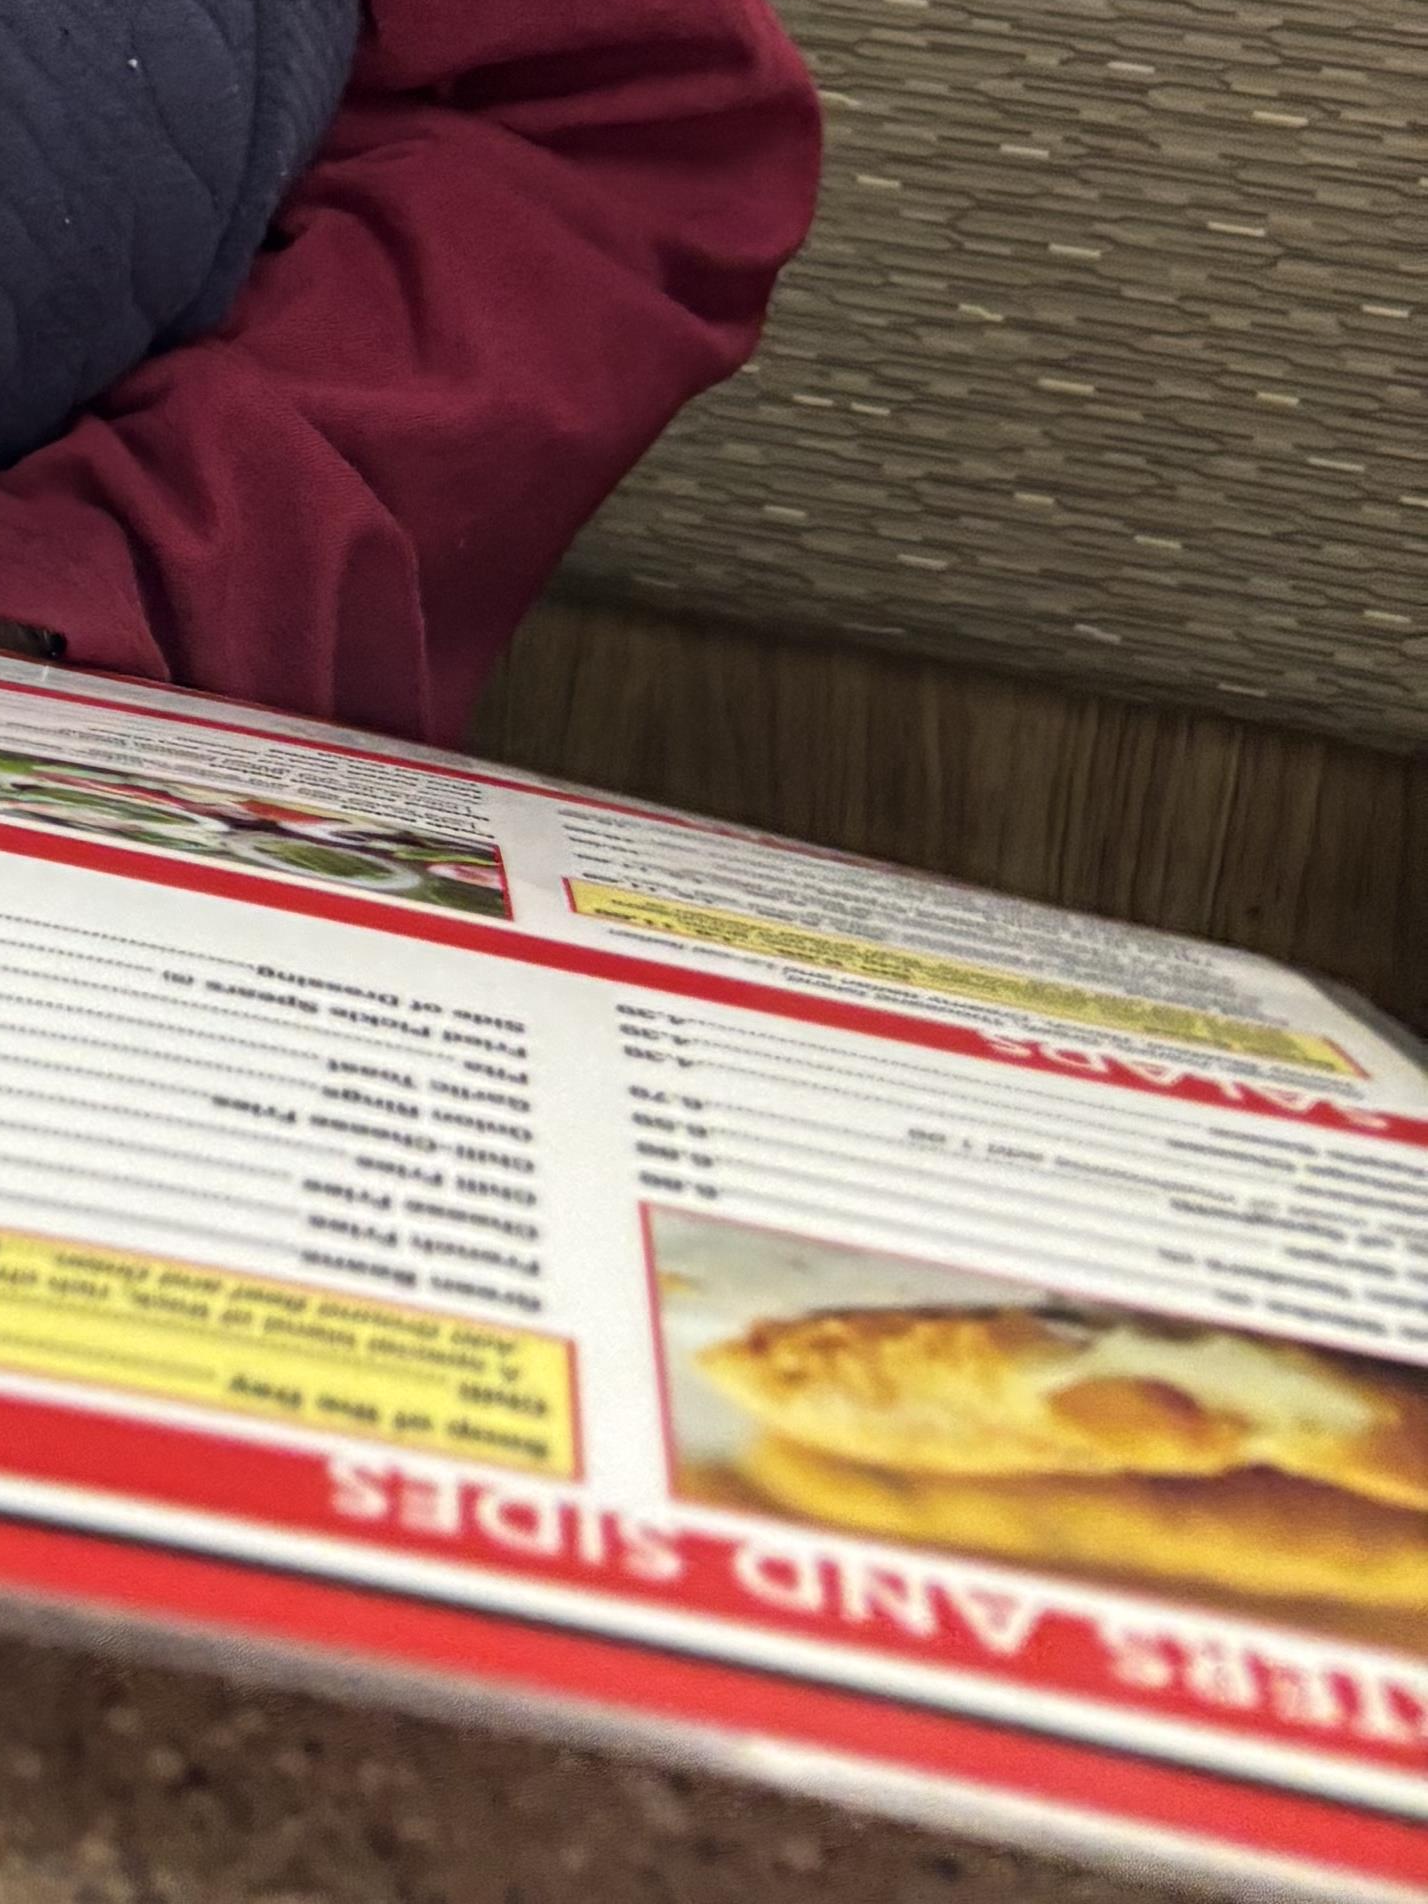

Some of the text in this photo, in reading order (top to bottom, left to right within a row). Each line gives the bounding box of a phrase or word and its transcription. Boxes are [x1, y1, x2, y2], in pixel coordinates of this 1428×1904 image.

[206, 979, 319, 1016] Spears
[258, 966, 525, 1035] Side of Dressing
[330, 1007, 431, 1039] Pickle
[443, 1031, 527, 1059] Fried
[329, 1058, 416, 1091] Toast
[975, 1029, 1390, 1131] SALADS
[322, 1084, 419, 1120] Rings
[431, 1081, 531, 1115] Garlic
[432, 1111, 533, 1144] Onion
[327, 1459, 683, 1579] SIDES
[734, 1534, 1038, 1661] AND
